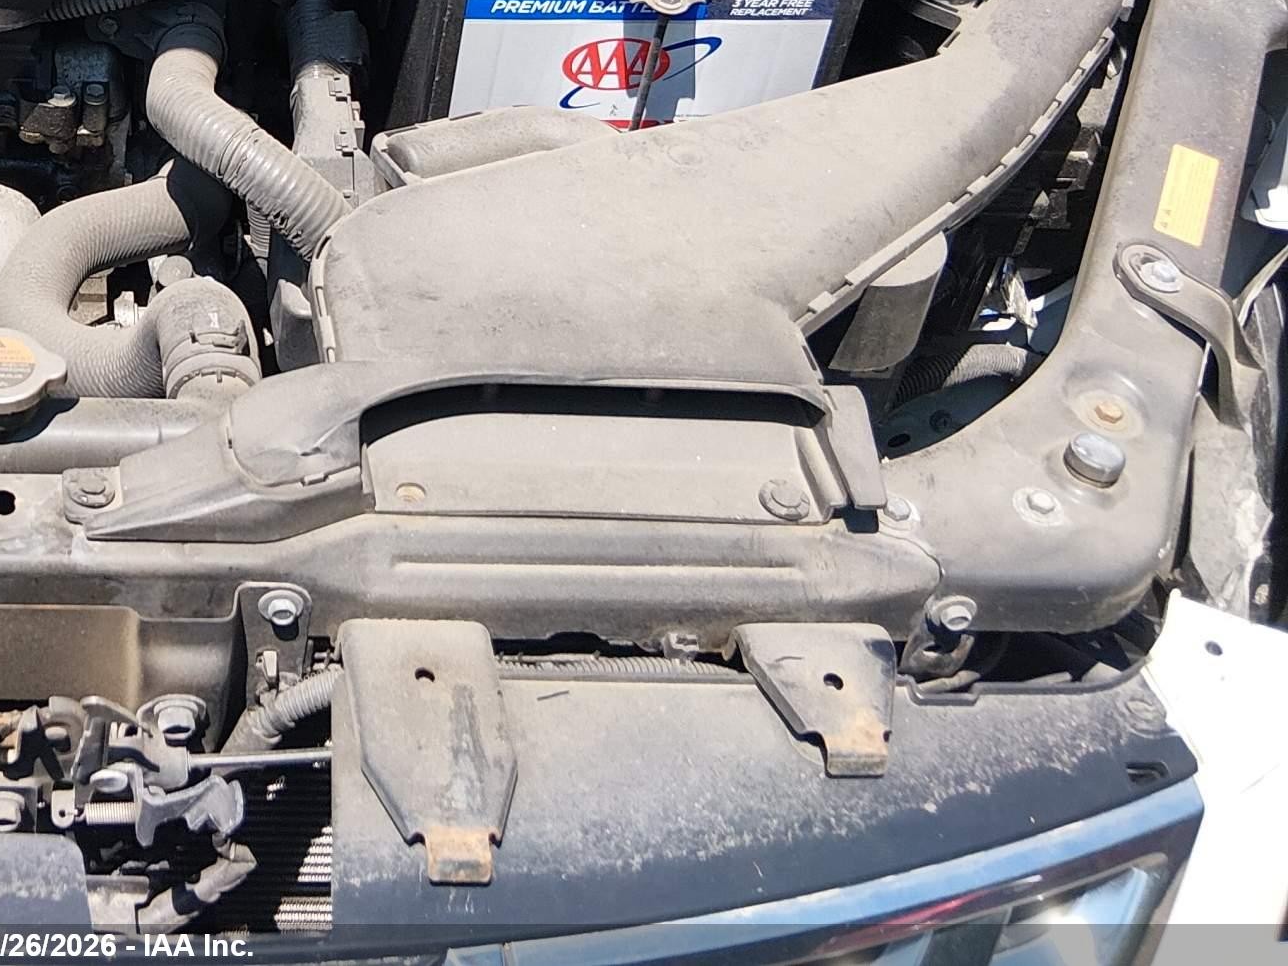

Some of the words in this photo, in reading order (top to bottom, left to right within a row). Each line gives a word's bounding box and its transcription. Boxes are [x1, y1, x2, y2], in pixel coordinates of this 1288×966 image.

[491, 0, 587, 14] PREMIUM
[588, 0, 658, 14] BATTE
[729, 8, 809, 16] REPLACEMENT
[565, 39, 667, 90] AAA
